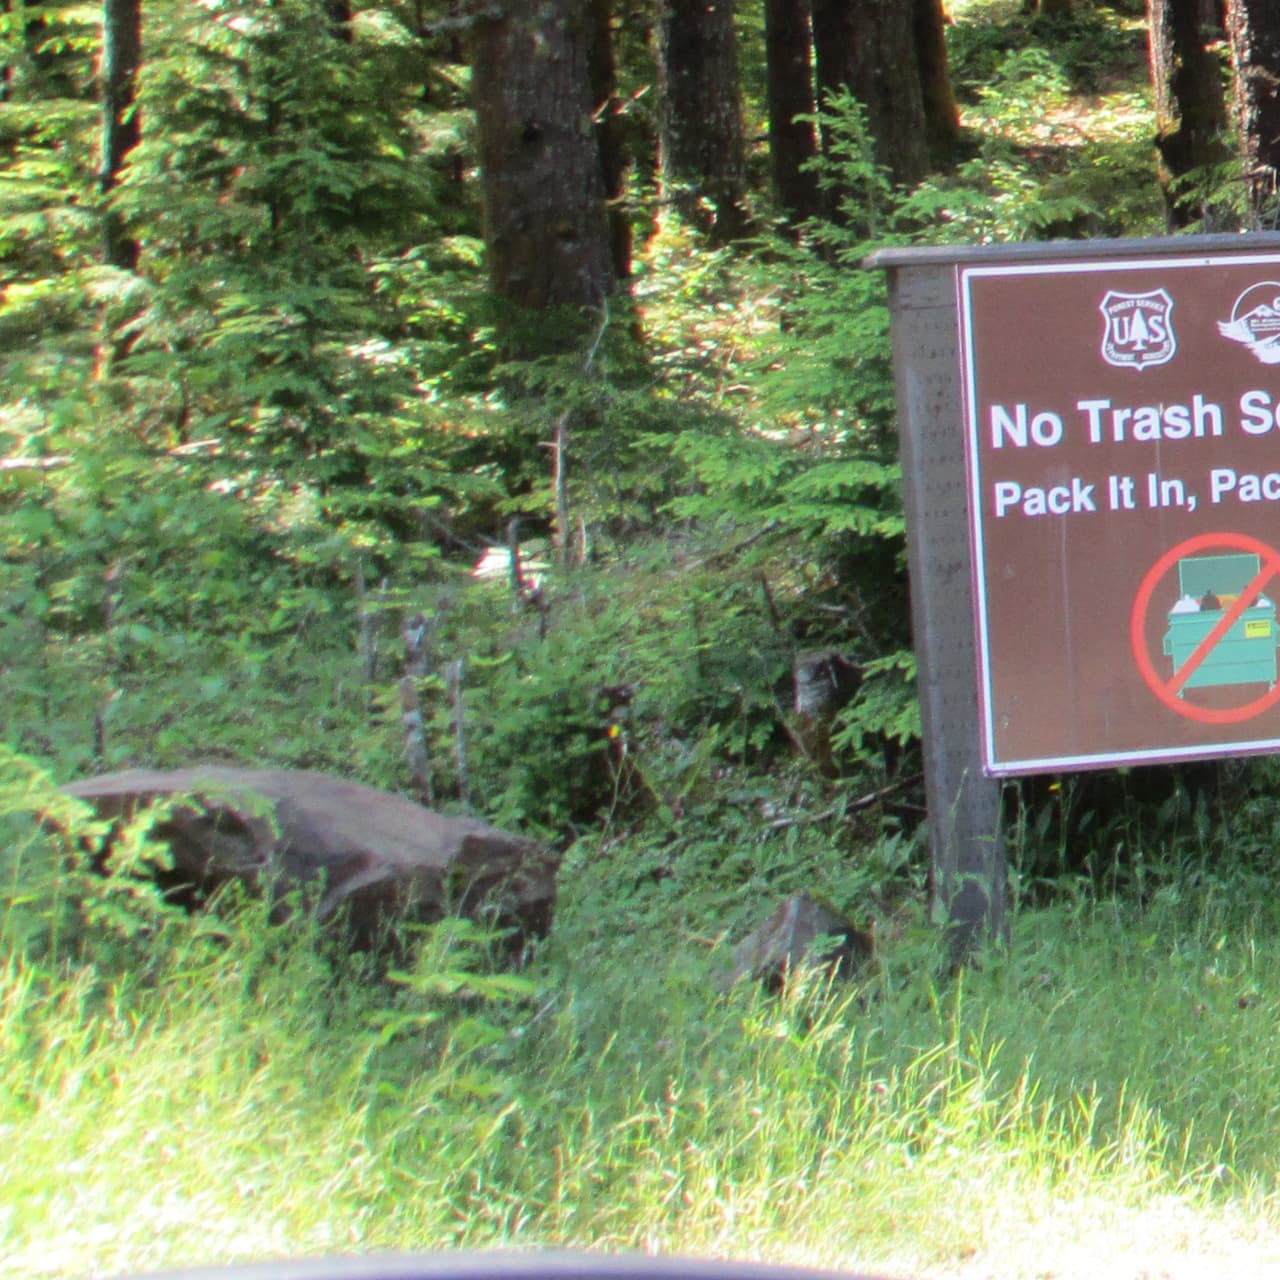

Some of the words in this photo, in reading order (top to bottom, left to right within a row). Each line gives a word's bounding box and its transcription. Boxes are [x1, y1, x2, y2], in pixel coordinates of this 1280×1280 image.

[990, 404, 1062, 448] No
[1077, 394, 1224, 444] Trash
[994, 477, 1096, 517] Pack
[1109, 475, 1135, 510] It
[1147, 473, 1197, 512] In,
